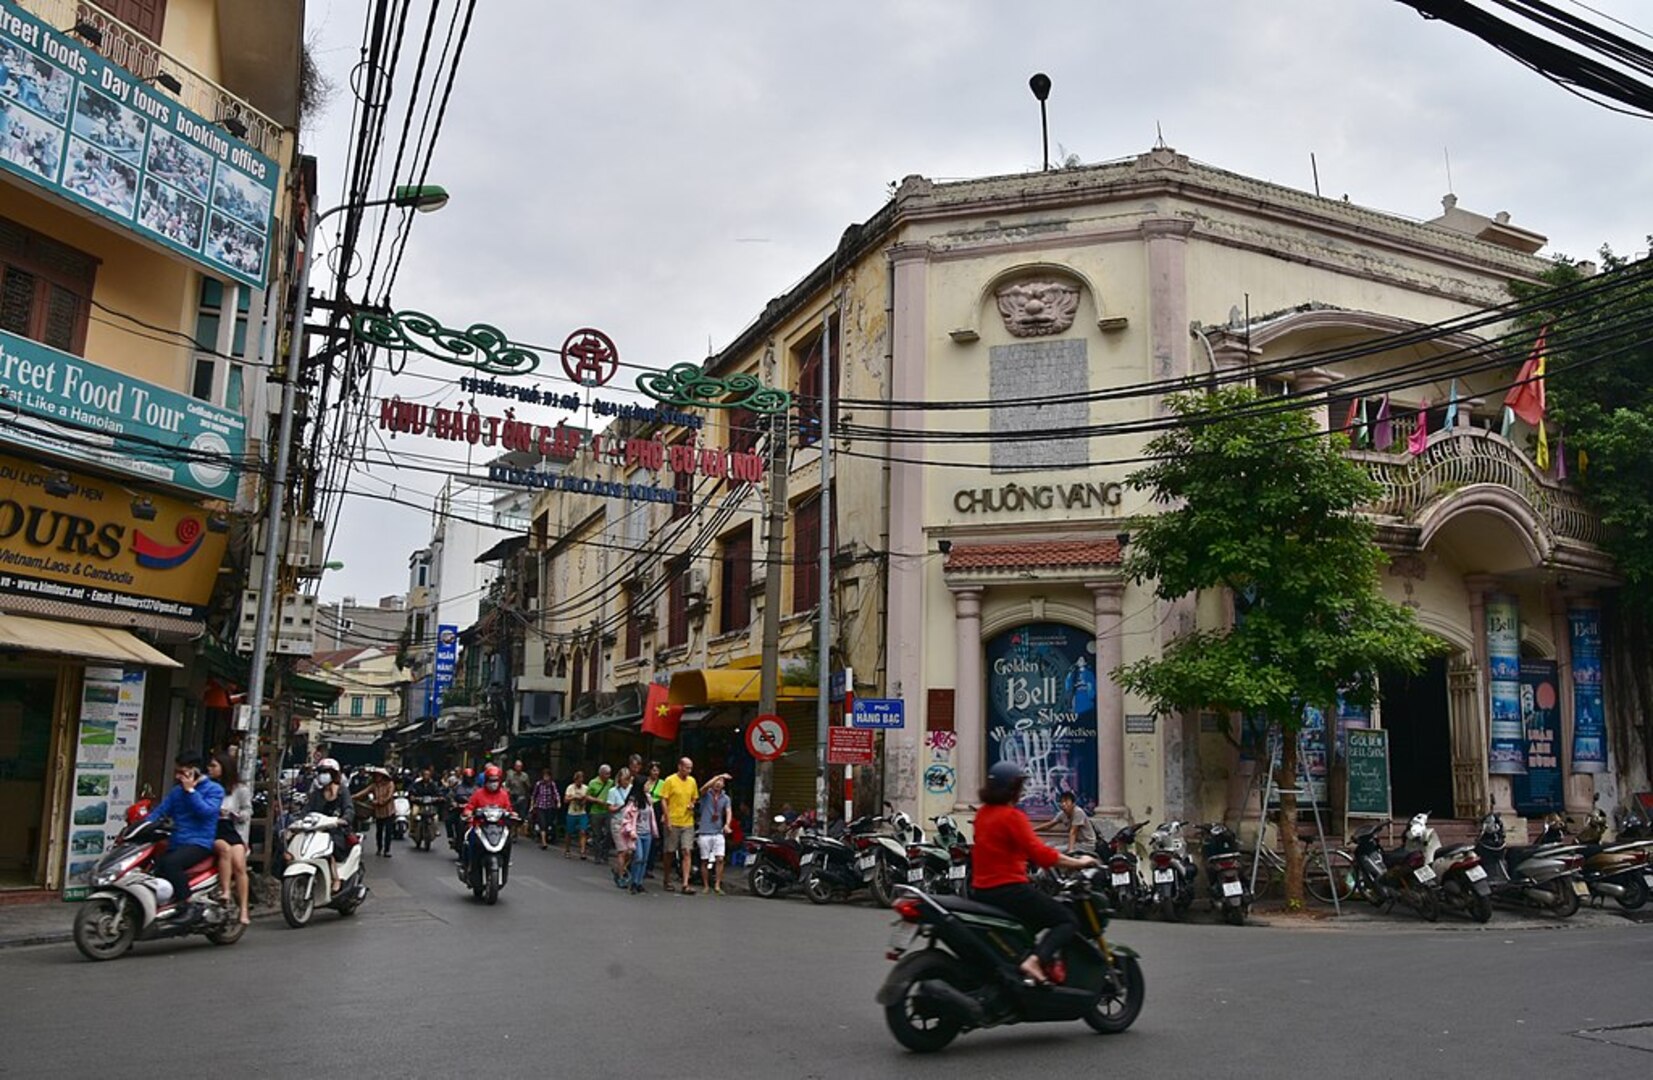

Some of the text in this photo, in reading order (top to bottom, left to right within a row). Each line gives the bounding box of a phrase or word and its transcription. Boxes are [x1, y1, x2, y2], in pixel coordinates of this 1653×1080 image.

[42, 31, 88, 75] foods
[101, 66, 130, 101] Day
[133, 82, 170, 123] tours
[175, 111, 228, 159] booking
[231, 141, 266, 180] office
[26, 392, 56, 413] Like
[59, 406, 67, 416] a
[70, 406, 124, 433] Hanoian
[61, 364, 124, 414] Food
[131, 386, 185, 433] Tour
[435, 401, 480, 444] BẢO
[485, 408, 531, 453] TỒN
[539, 417, 581, 460] CẤP
[626, 431, 664, 472] PHỐ
[953, 482, 1054, 514] CHUÔNG
[72, 563, 81, 575] &
[83, 564, 134, 585] Cambodia
[994, 658, 1039, 676] Golden
[1006, 676, 1057, 712] Bell
[856, 710, 900, 726] HÀNG BẠC
[1037, 707, 1079, 726] Show
